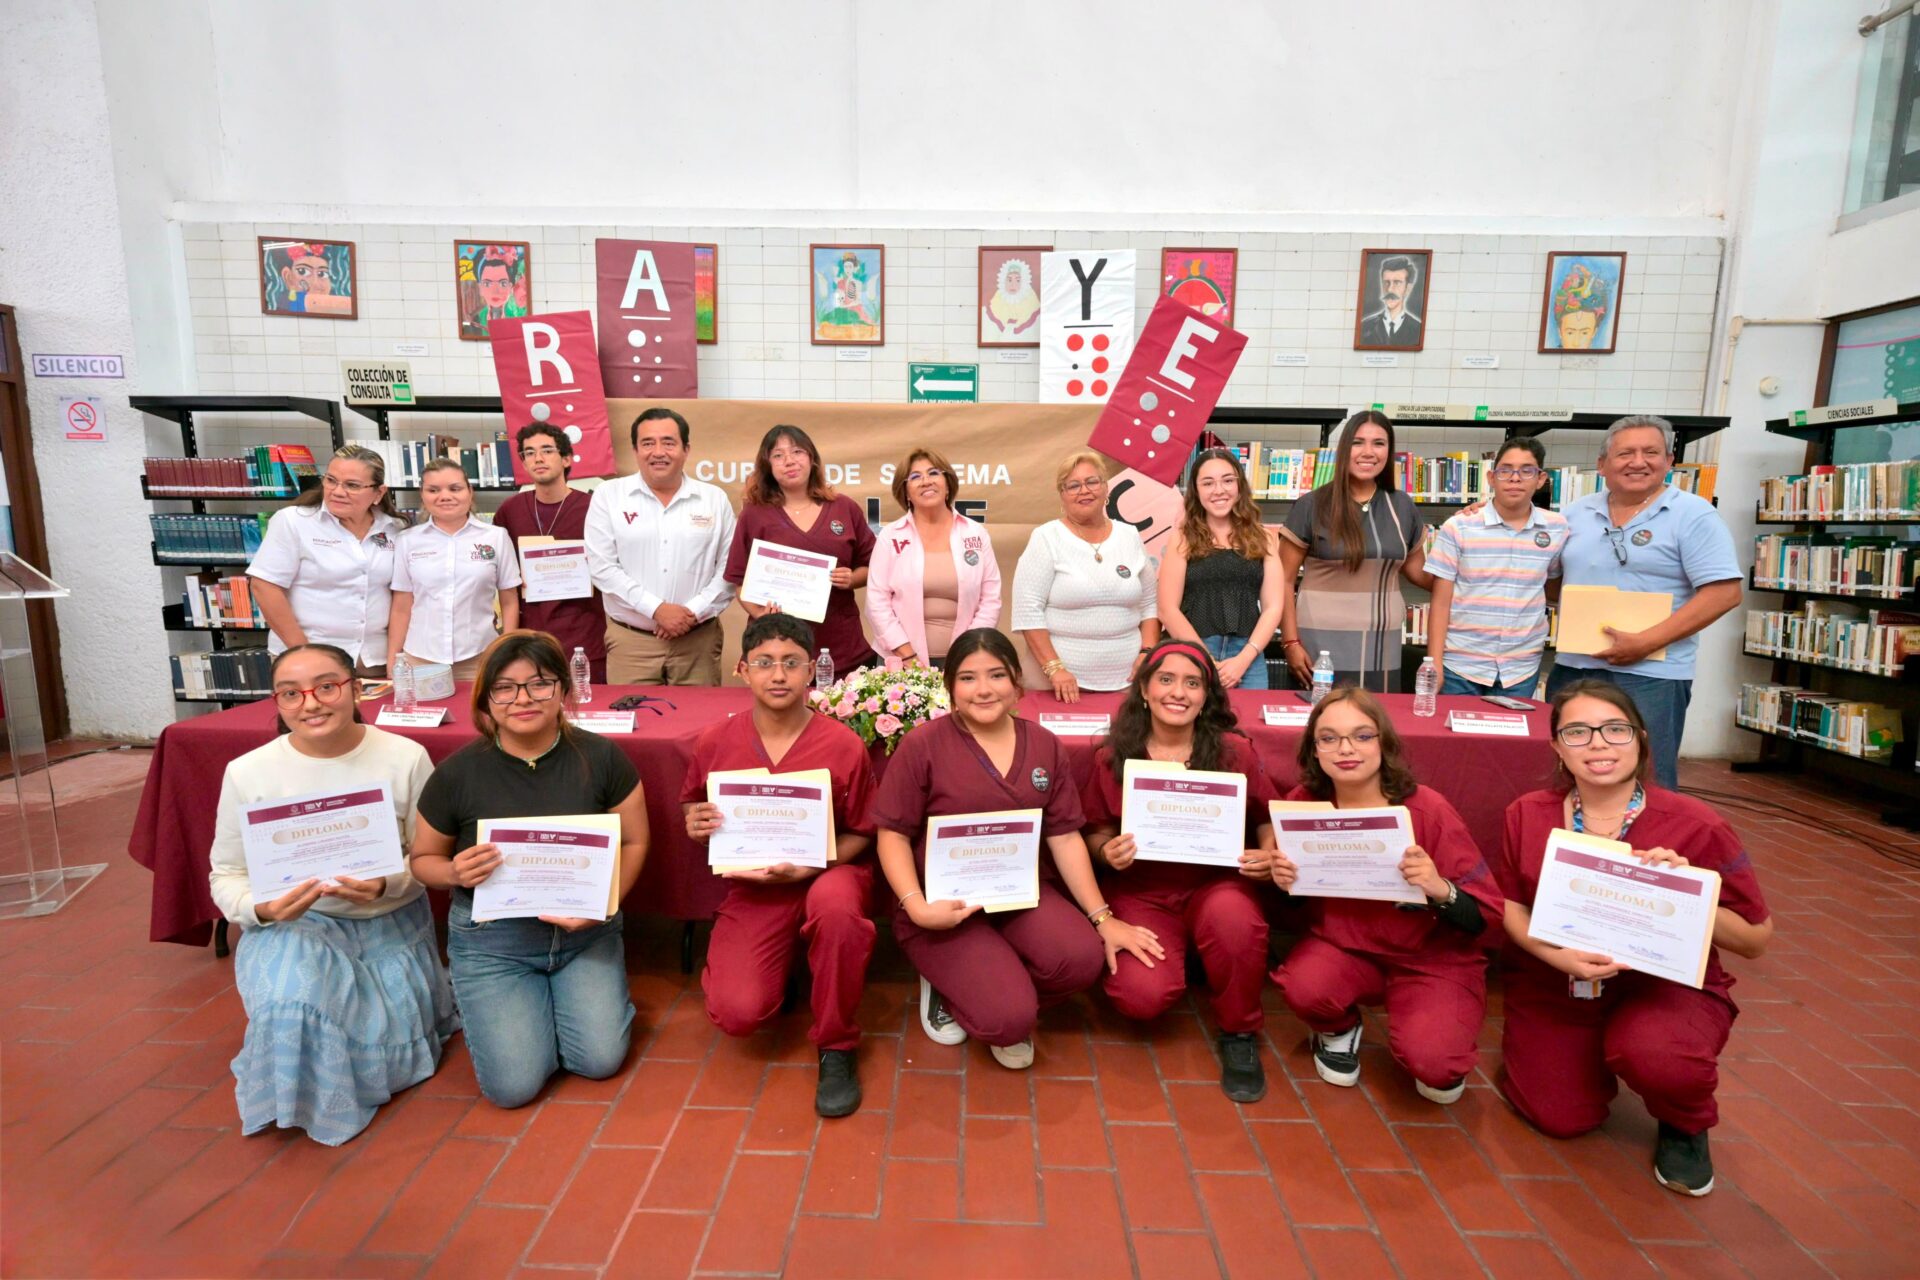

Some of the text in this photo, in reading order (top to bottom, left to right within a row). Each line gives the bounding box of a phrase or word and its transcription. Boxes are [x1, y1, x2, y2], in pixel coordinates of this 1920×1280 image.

[620, 249, 671, 312] A
[1069, 258, 1108, 321] Y
[521, 322, 575, 387] R
[1158, 315, 1220, 391] E
[38, 358, 117, 374] SILENCIO
[347, 363, 409, 383] COLECCIÓN DE
[350, 384, 392, 400] CONSULTA
[1827, 405, 1874, 420] CIENCIAS SOCIALES
[825, 463, 862, 486] DE
[879, 463, 1012, 486] SEMA
[542, 562, 571, 570] DIPLOMA
[774, 567, 807, 579] DIPLOMA
[747, 808, 795, 818] DIPLOMA
[1160, 803, 1209, 815] DIPLOMA
[291, 820, 353, 840] DIPLOMA
[961, 846, 1006, 858] DIPLOMA
[1317, 842, 1371, 852] DIPLOMA
[521, 856, 576, 867] DIPLOMA
[1588, 884, 1656, 911] DIPLOMA
